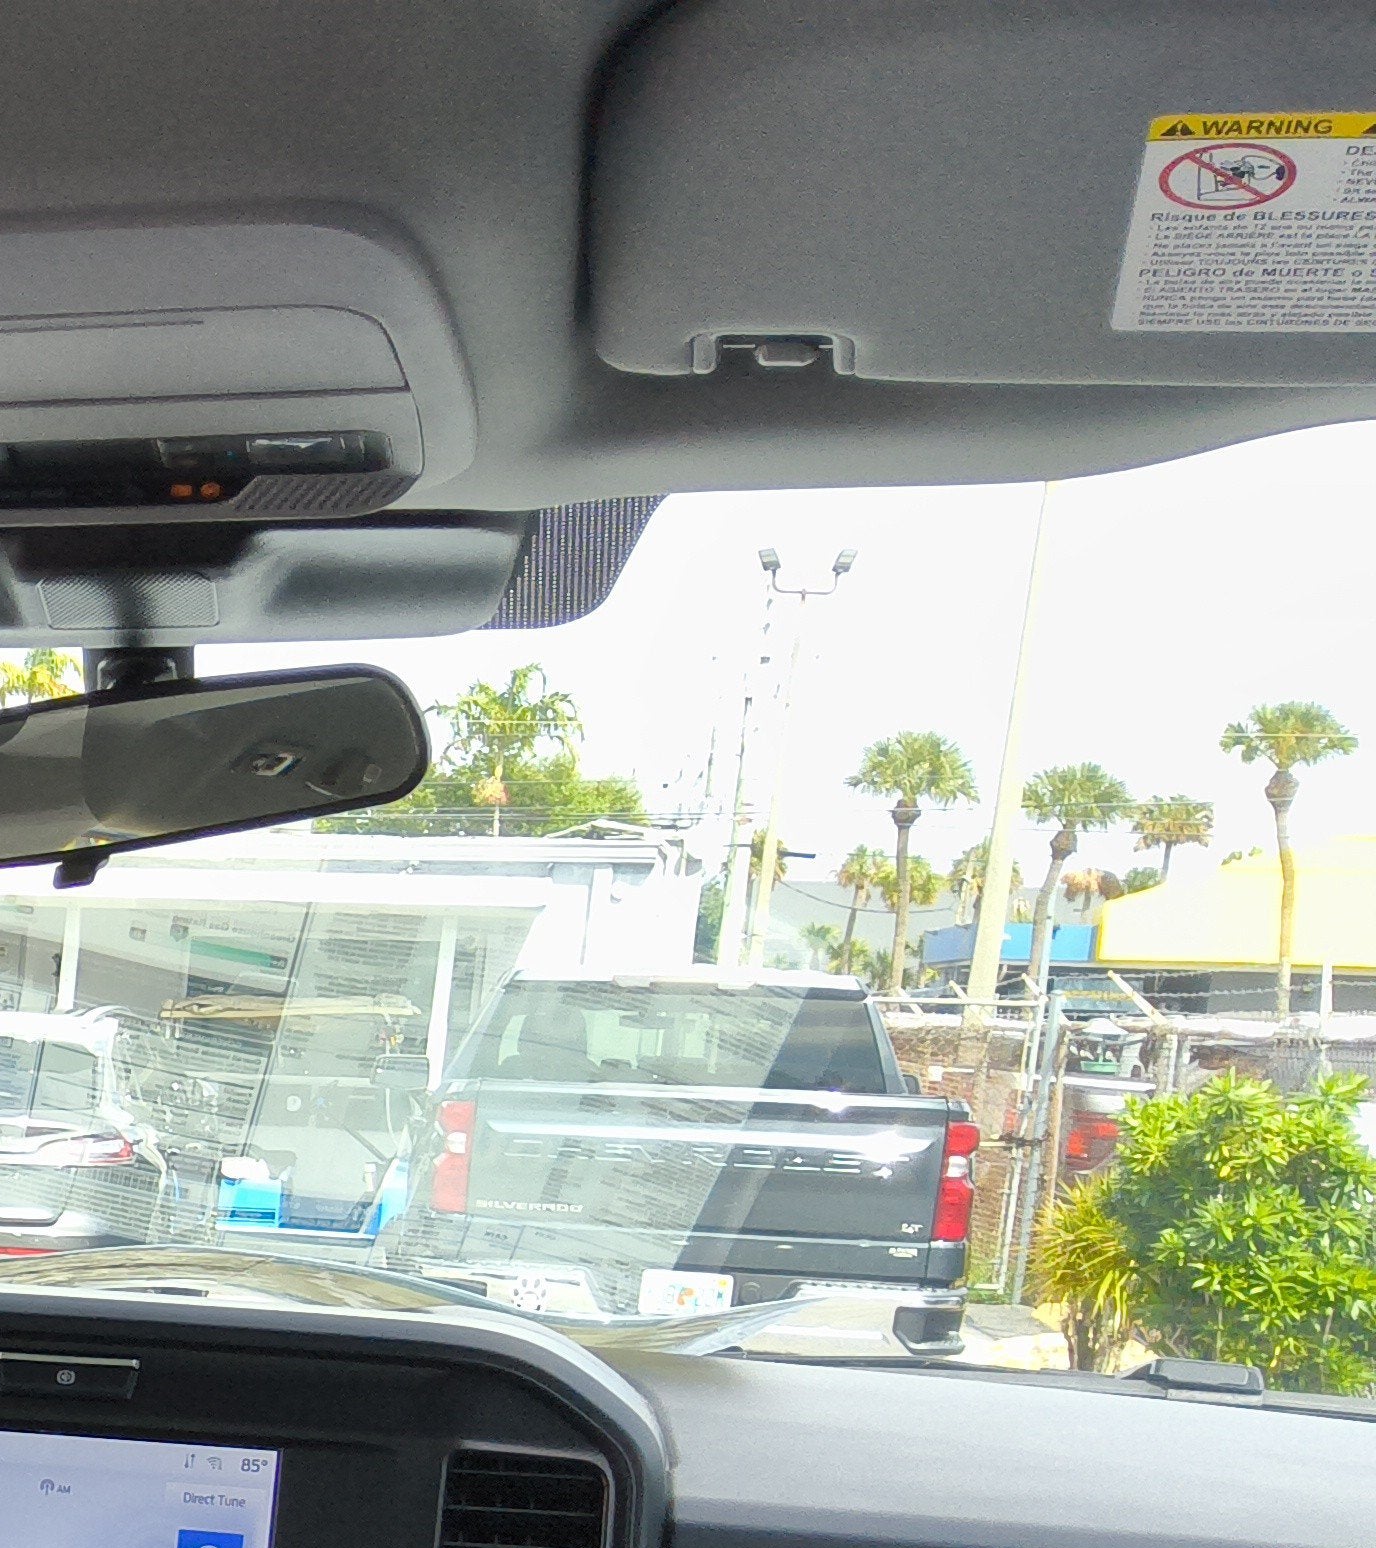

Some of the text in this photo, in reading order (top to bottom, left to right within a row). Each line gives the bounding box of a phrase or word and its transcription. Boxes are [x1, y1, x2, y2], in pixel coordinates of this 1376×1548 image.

[1201, 118, 1334, 136] WARNING
[476, 1198, 584, 1214] SILVERADO
[56, 1483, 72, 1496] AM
[183, 1490, 247, 1510] Direct Tune
